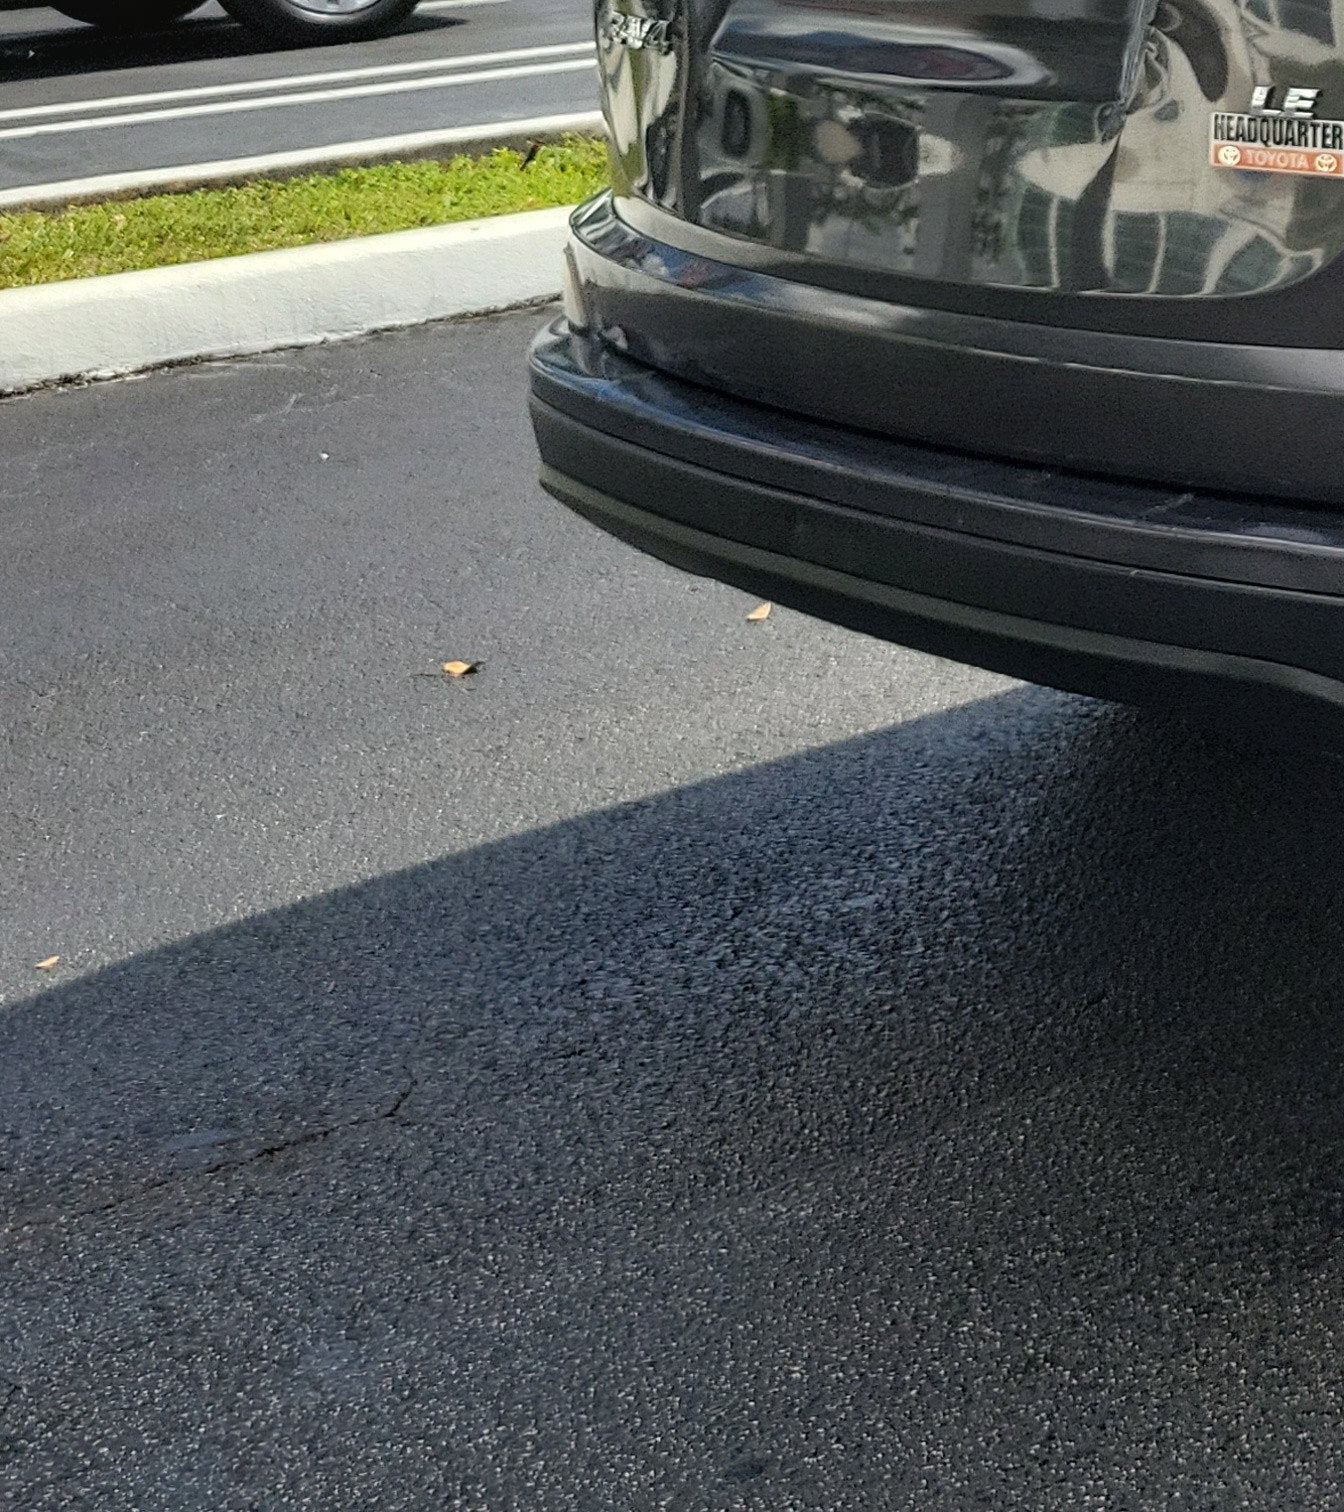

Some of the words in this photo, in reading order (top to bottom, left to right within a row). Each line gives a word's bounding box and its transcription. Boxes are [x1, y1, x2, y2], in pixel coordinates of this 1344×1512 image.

[1251, 86, 1321, 118] LE
[1213, 113, 1344, 150] HEADQUARTER
[1244, 149, 1310, 170] TOYOTA
